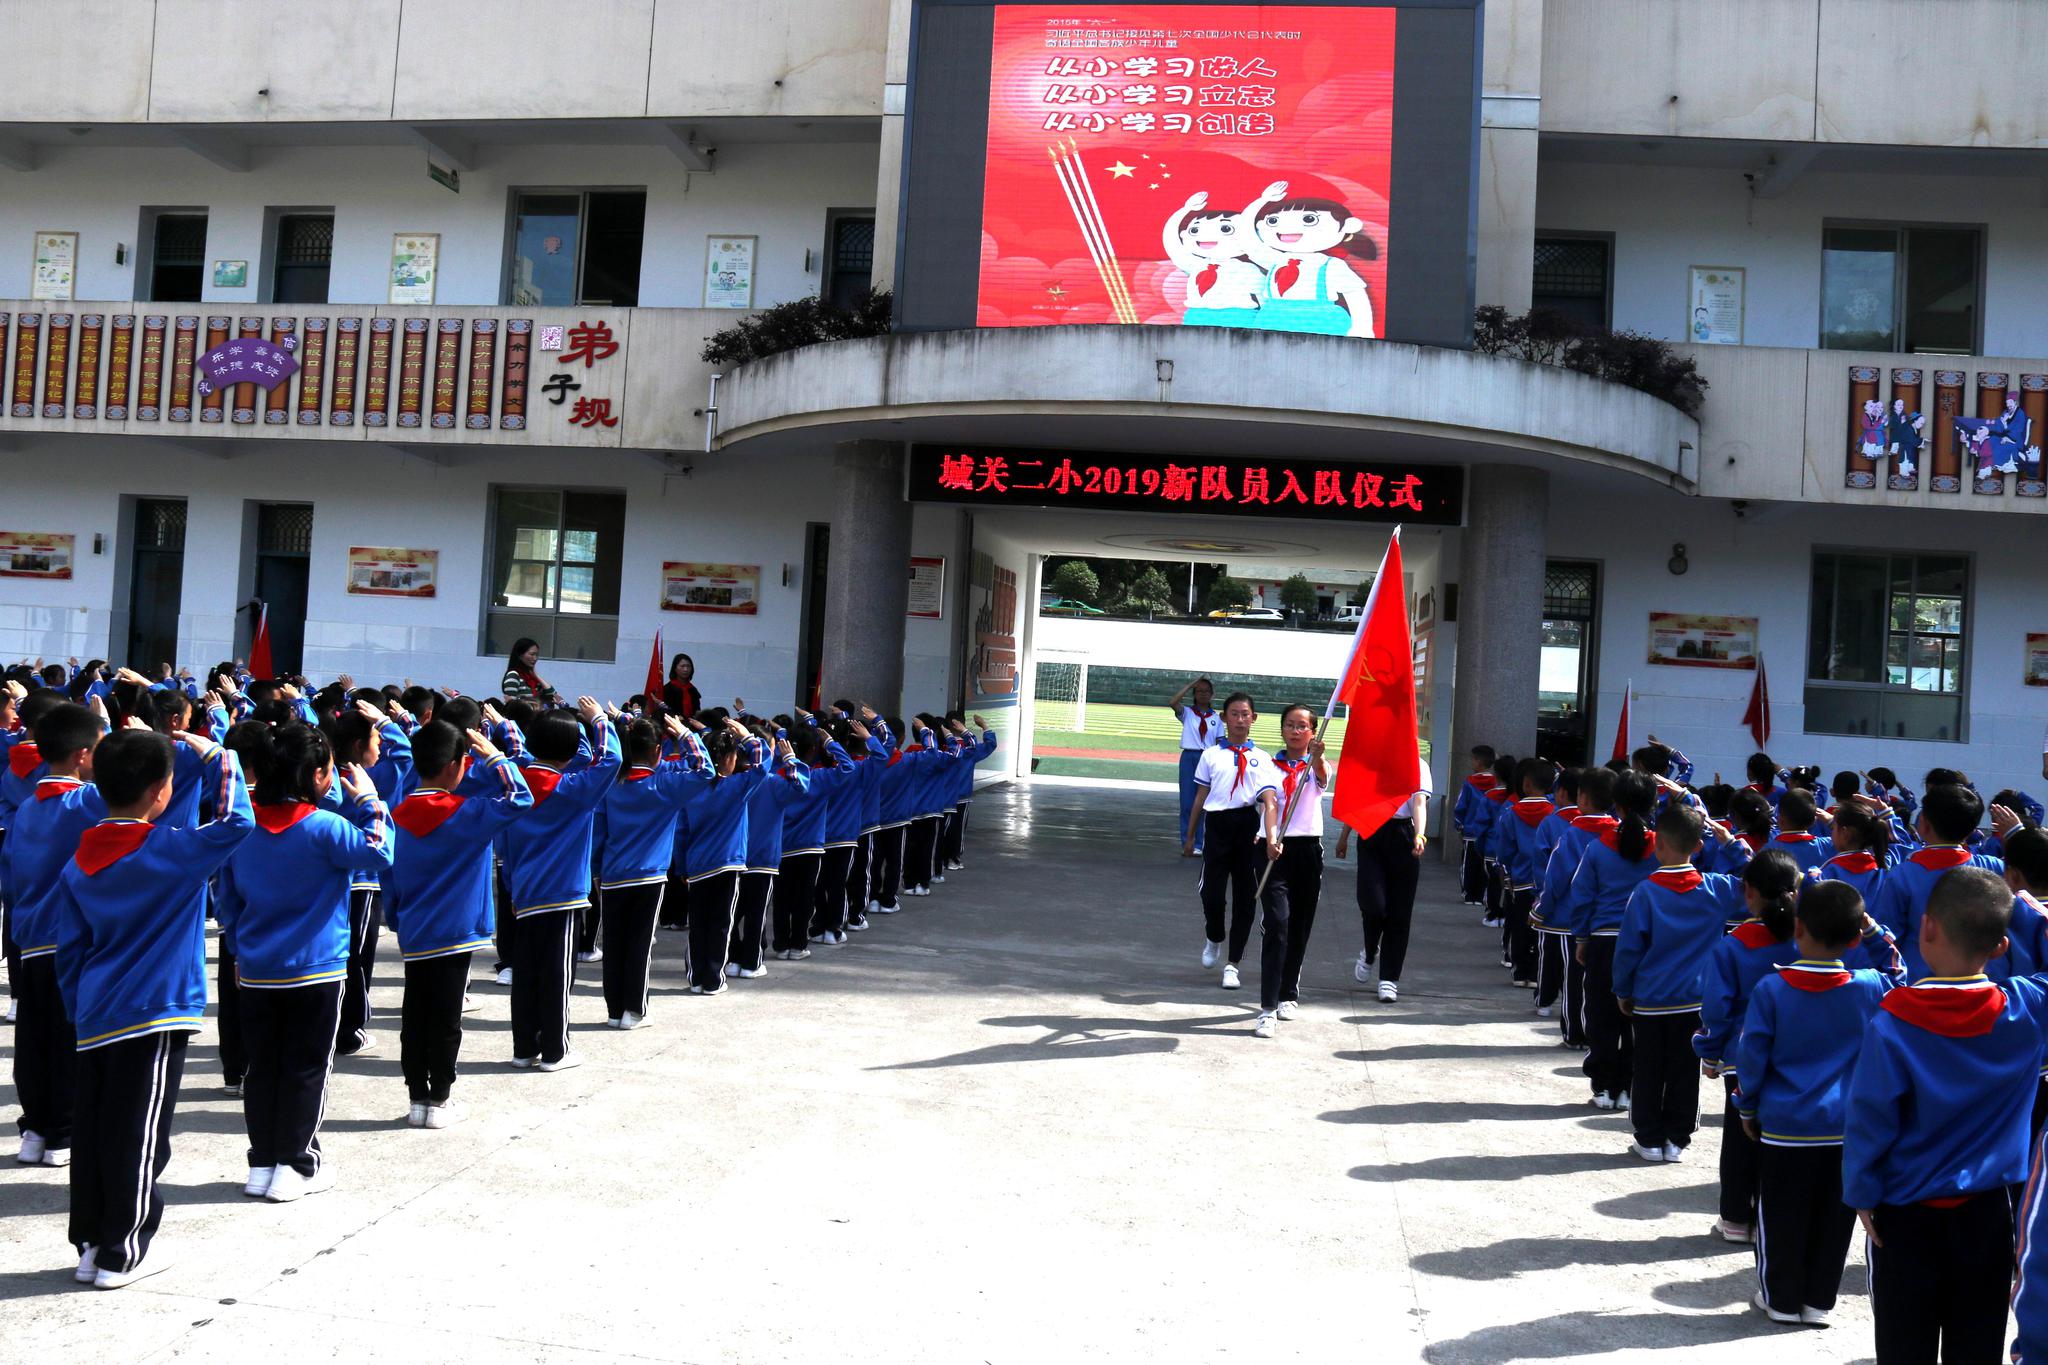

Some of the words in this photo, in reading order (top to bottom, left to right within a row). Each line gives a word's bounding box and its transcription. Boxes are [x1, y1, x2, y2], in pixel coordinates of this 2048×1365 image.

[1044, 55, 1278, 79] 从小学习做人
[1043, 84, 1277, 108] 从小学习立志
[1042, 112, 1276, 136] 从小学习创造
[541, 320, 619, 428] 弟子规
[937, 453, 1424, 512] 城关二小2019新队员入队仪式
